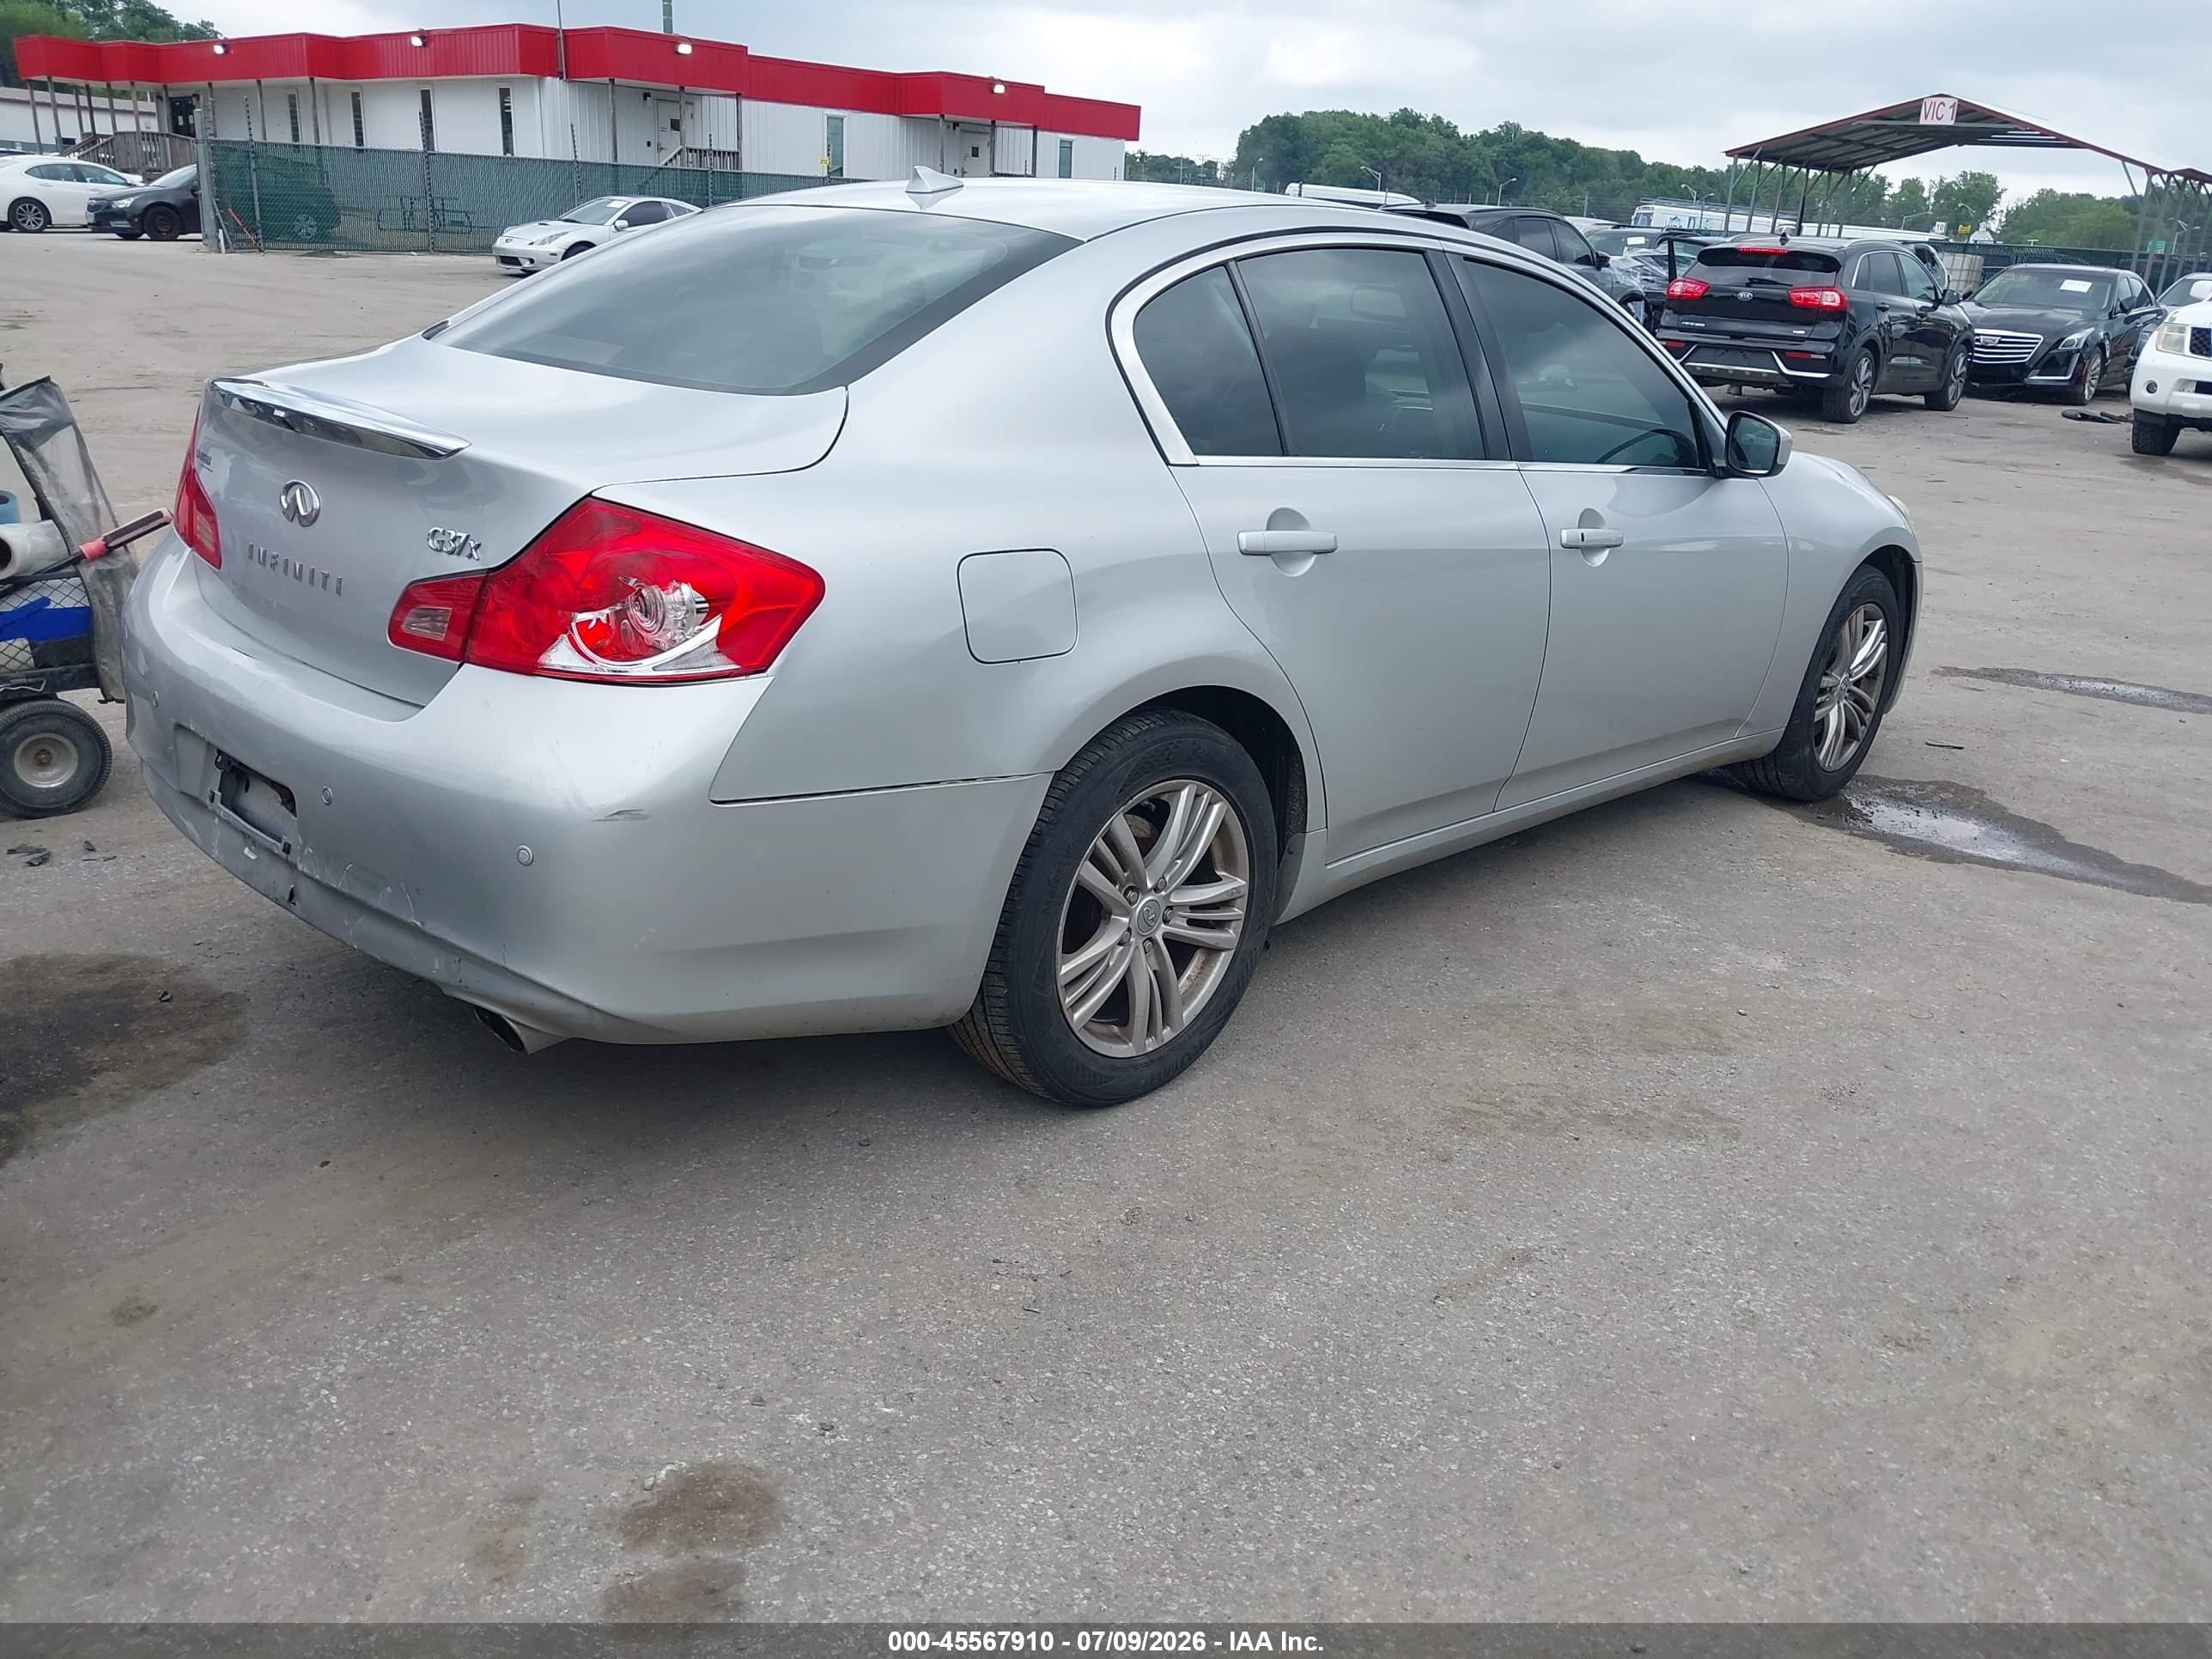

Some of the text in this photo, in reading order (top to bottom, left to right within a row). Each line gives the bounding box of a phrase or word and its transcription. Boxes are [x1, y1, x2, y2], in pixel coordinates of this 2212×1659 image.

[1923, 100, 1957, 121] VIC 1
[247, 542, 343, 597] INFINITI
